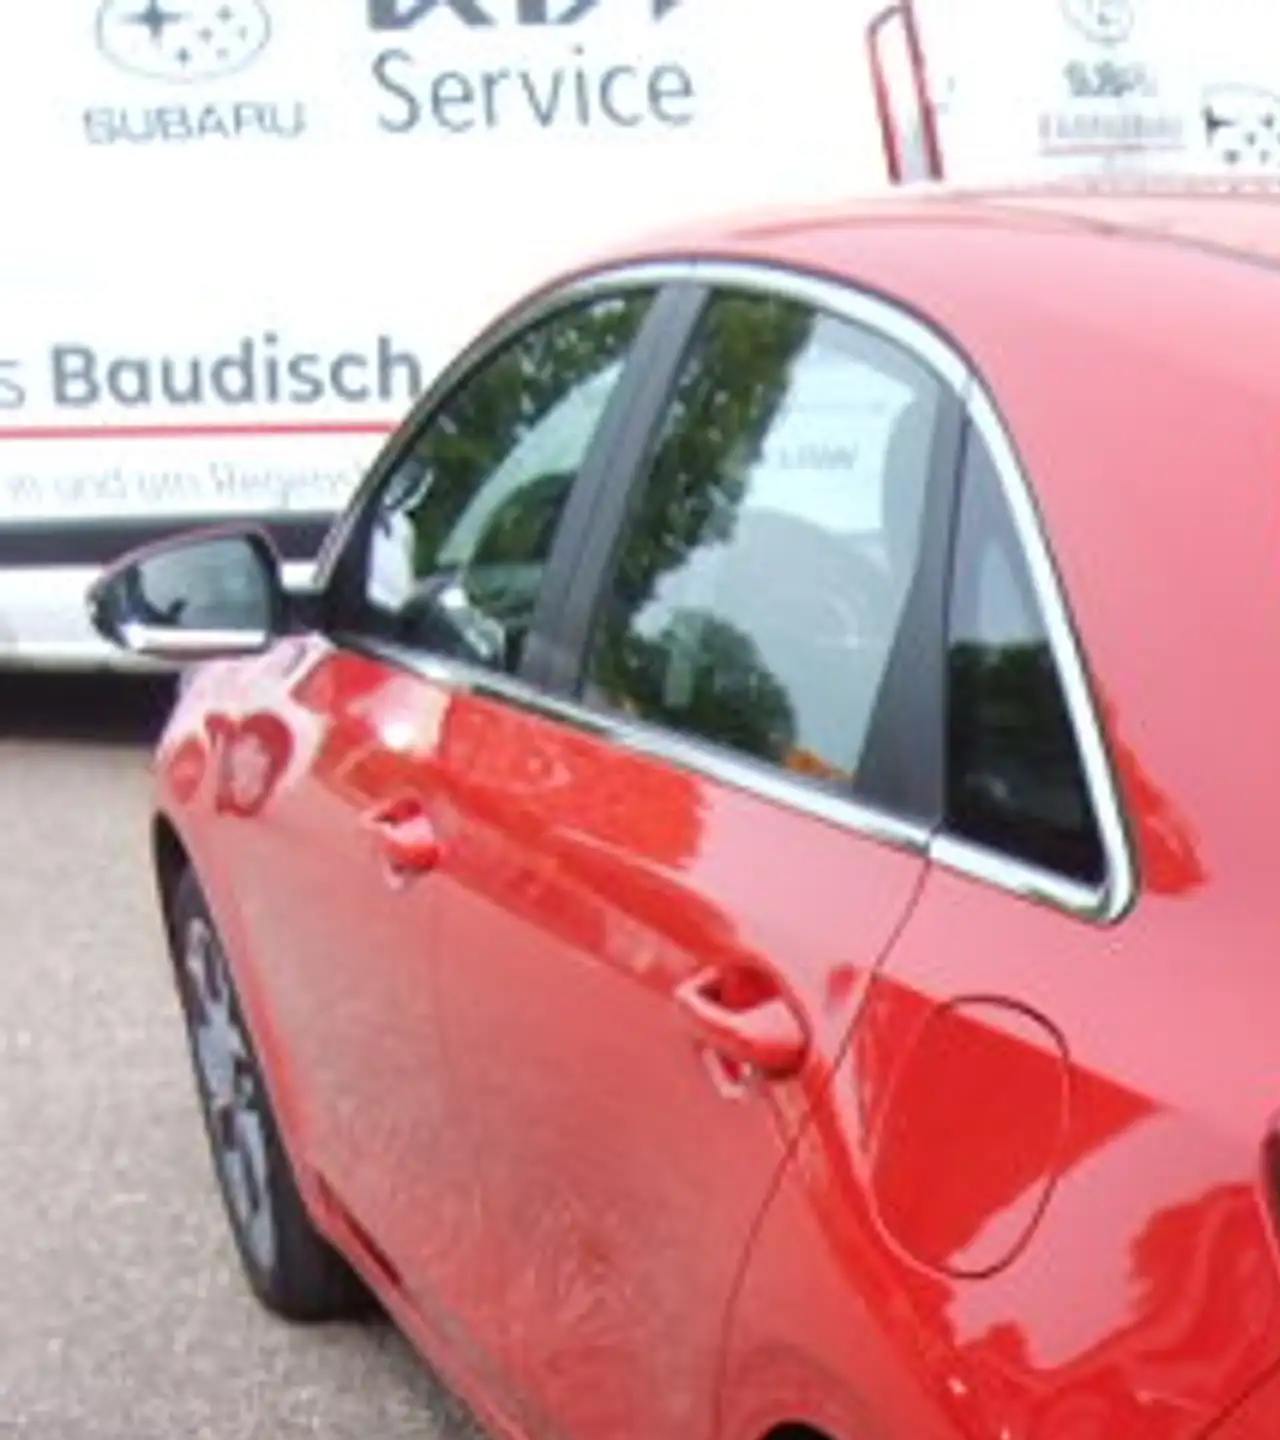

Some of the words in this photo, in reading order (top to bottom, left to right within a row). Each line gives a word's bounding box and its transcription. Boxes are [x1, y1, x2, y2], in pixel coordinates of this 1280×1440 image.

[83, 101, 306, 144] SUBARU
[371, 43, 697, 133] Service
[51, 331, 422, 407] Baudisch
